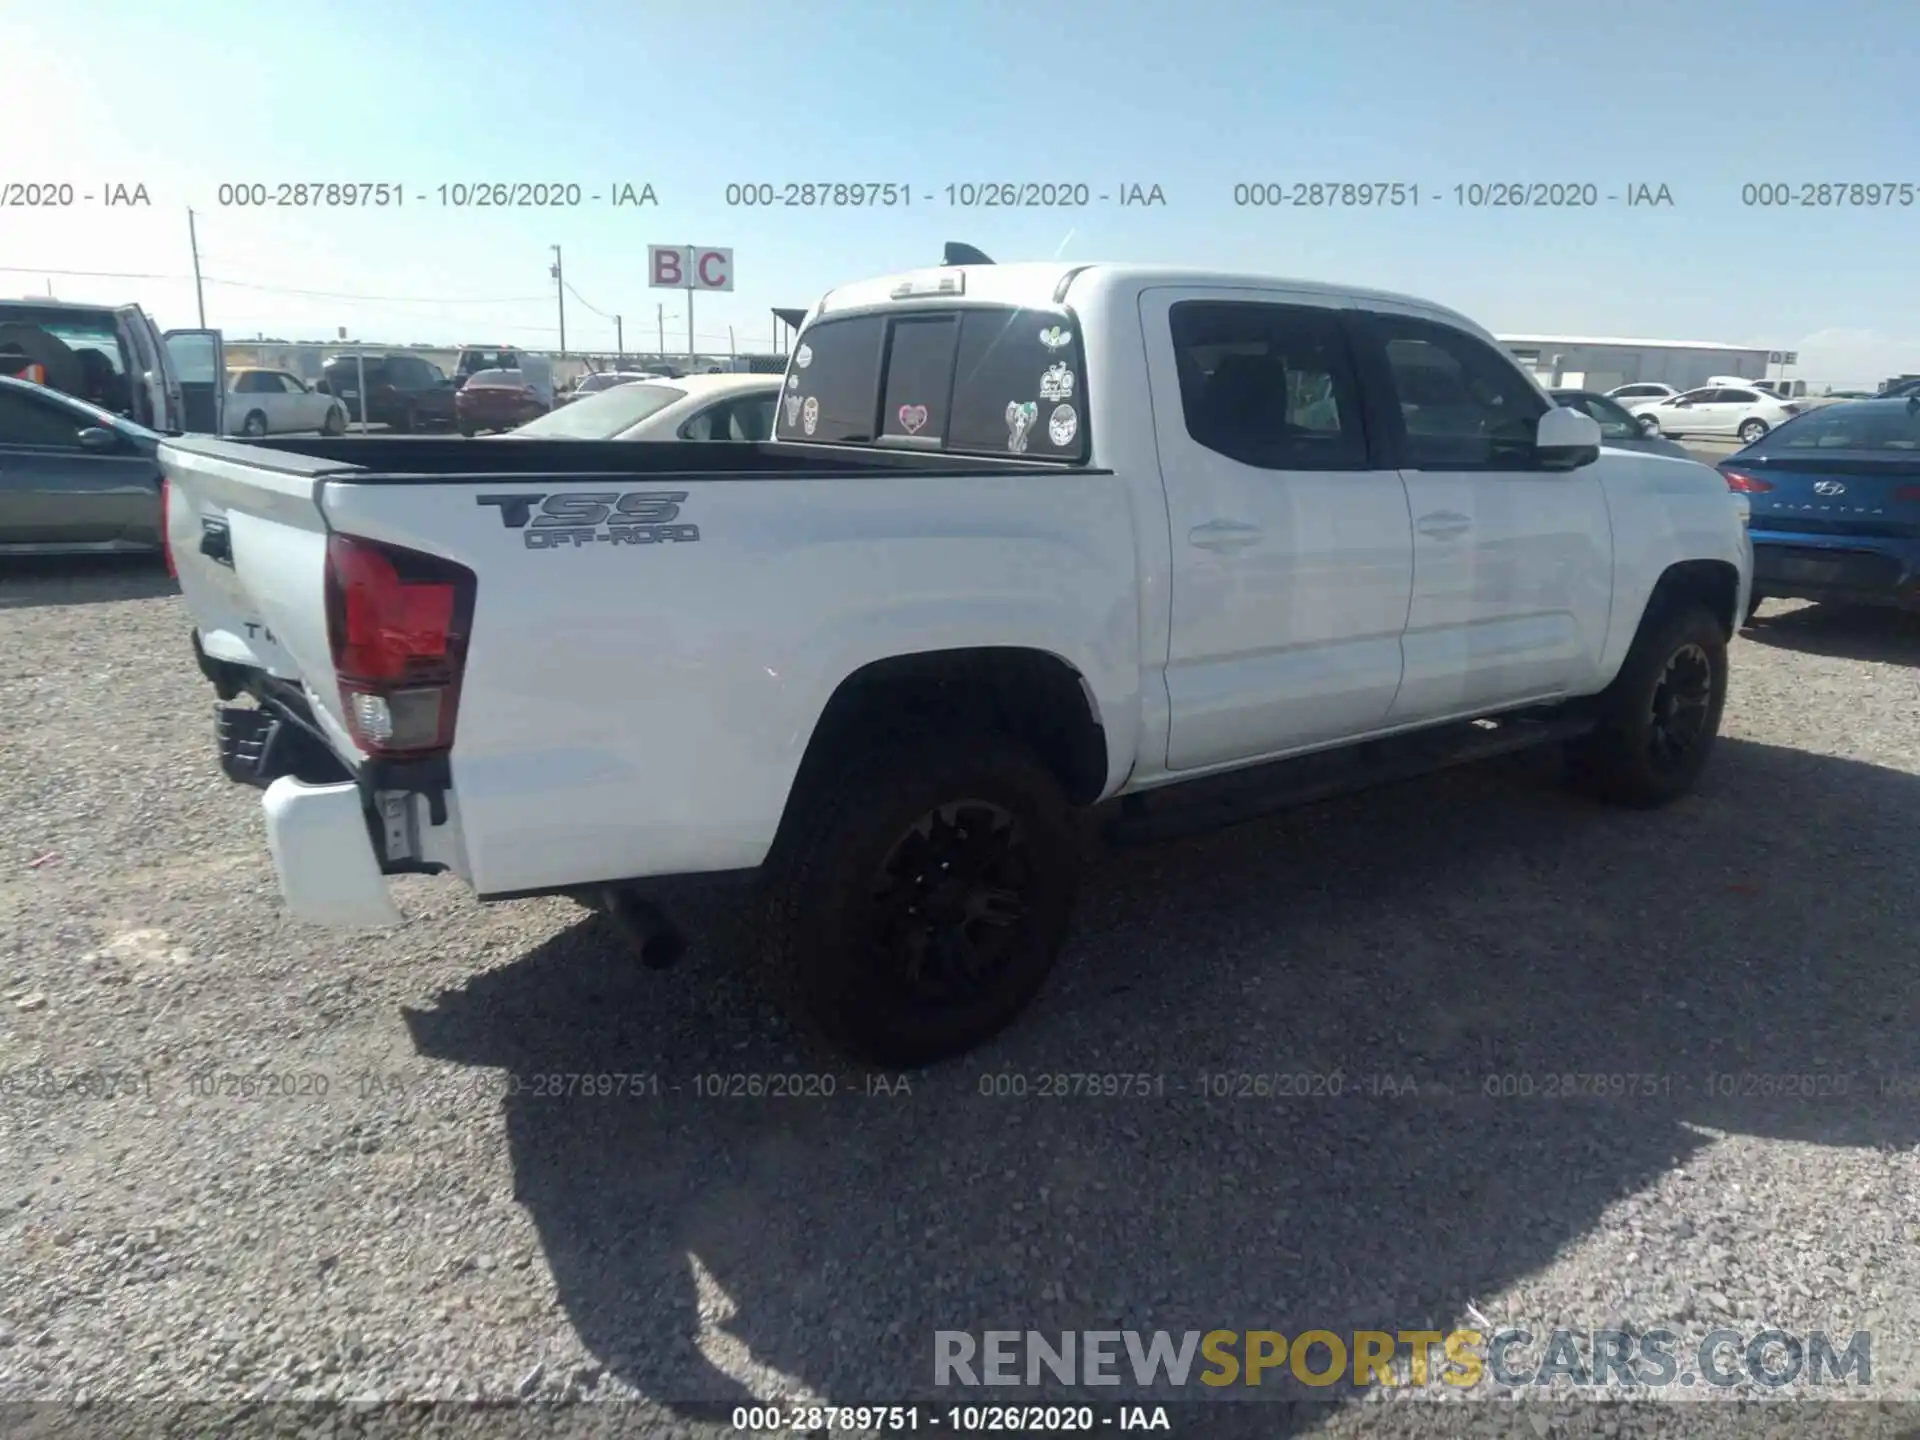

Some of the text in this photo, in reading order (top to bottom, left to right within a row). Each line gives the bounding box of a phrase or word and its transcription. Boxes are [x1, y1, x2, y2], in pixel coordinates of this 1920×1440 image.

[655, 249, 726, 287] B C
[476, 491, 689, 528] TSS
[523, 525, 700, 549] OFF-ROAD
